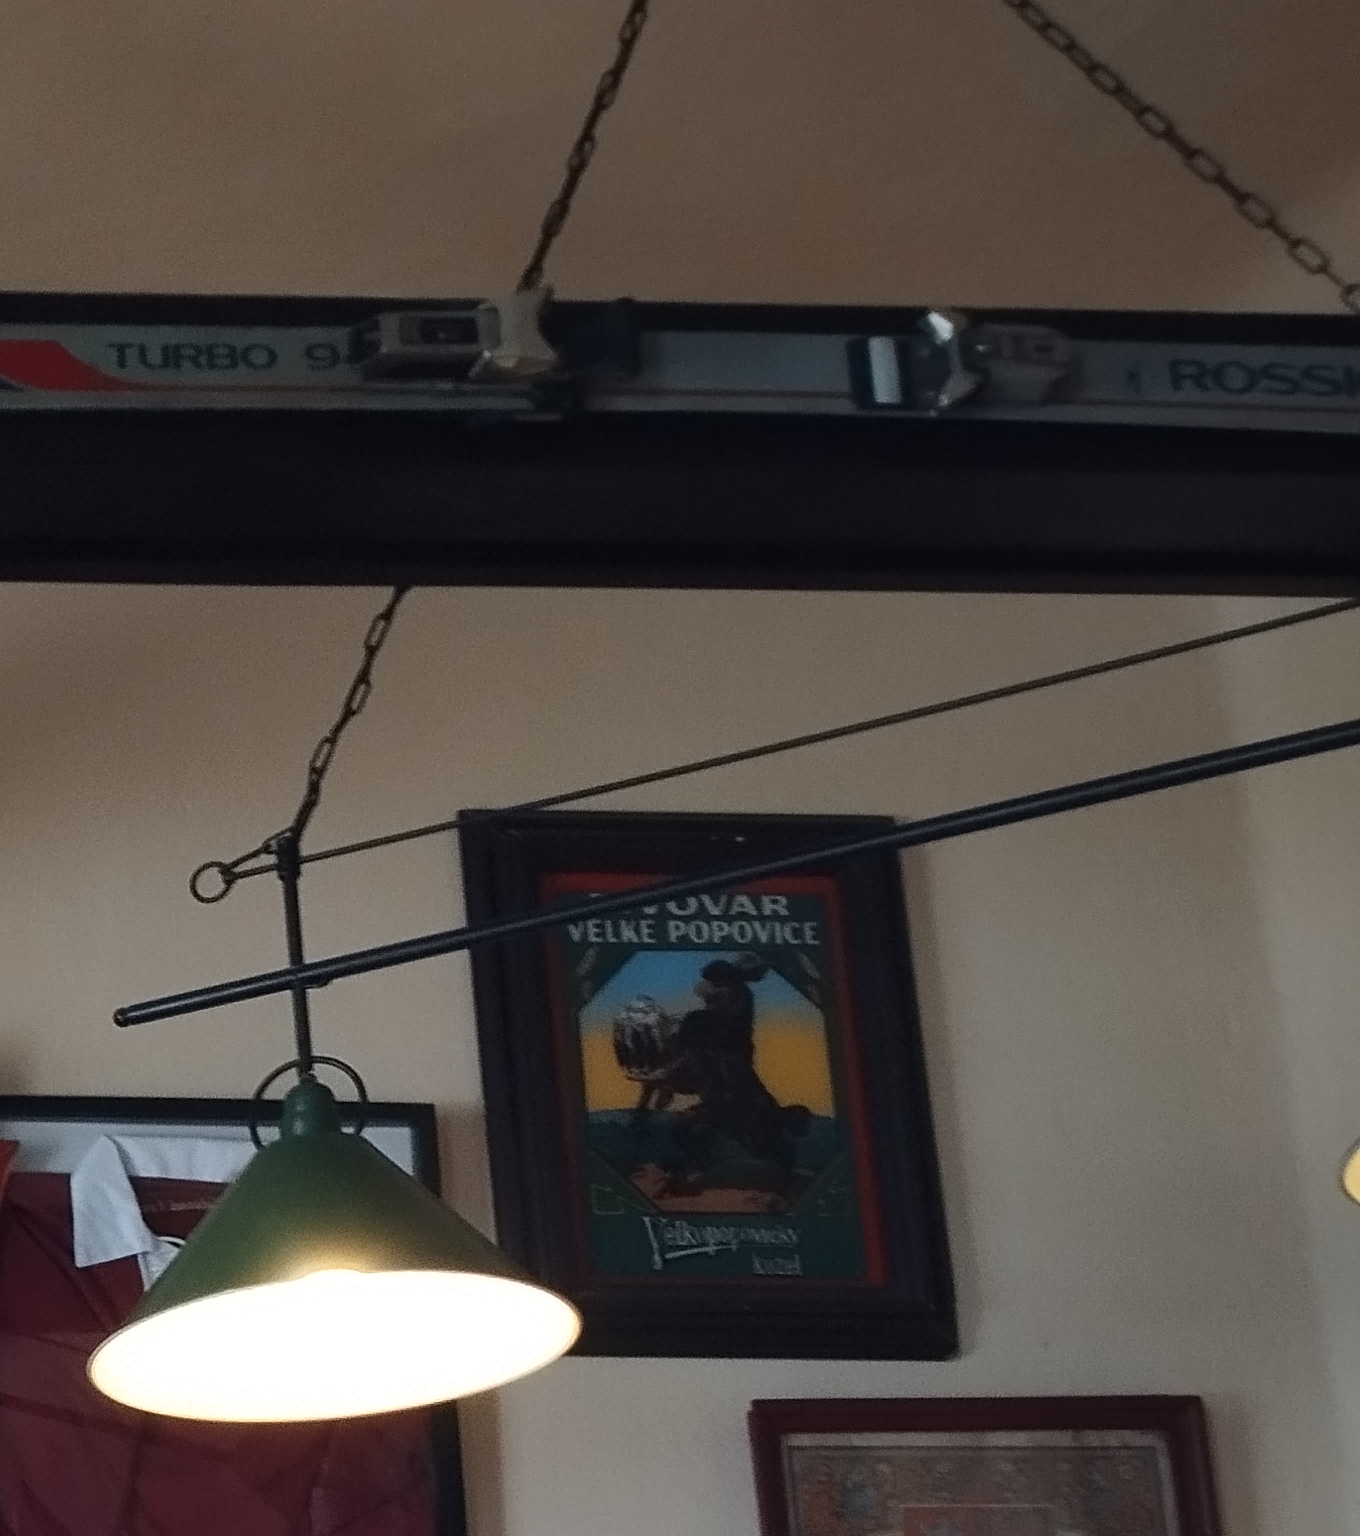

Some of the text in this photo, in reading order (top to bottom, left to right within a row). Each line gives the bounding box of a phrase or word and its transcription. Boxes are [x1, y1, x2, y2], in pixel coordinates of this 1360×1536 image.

[107, 342, 278, 371] TURBO
[1171, 359, 1360, 397] ROSSI
[667, 919, 821, 945] POPOVICE
